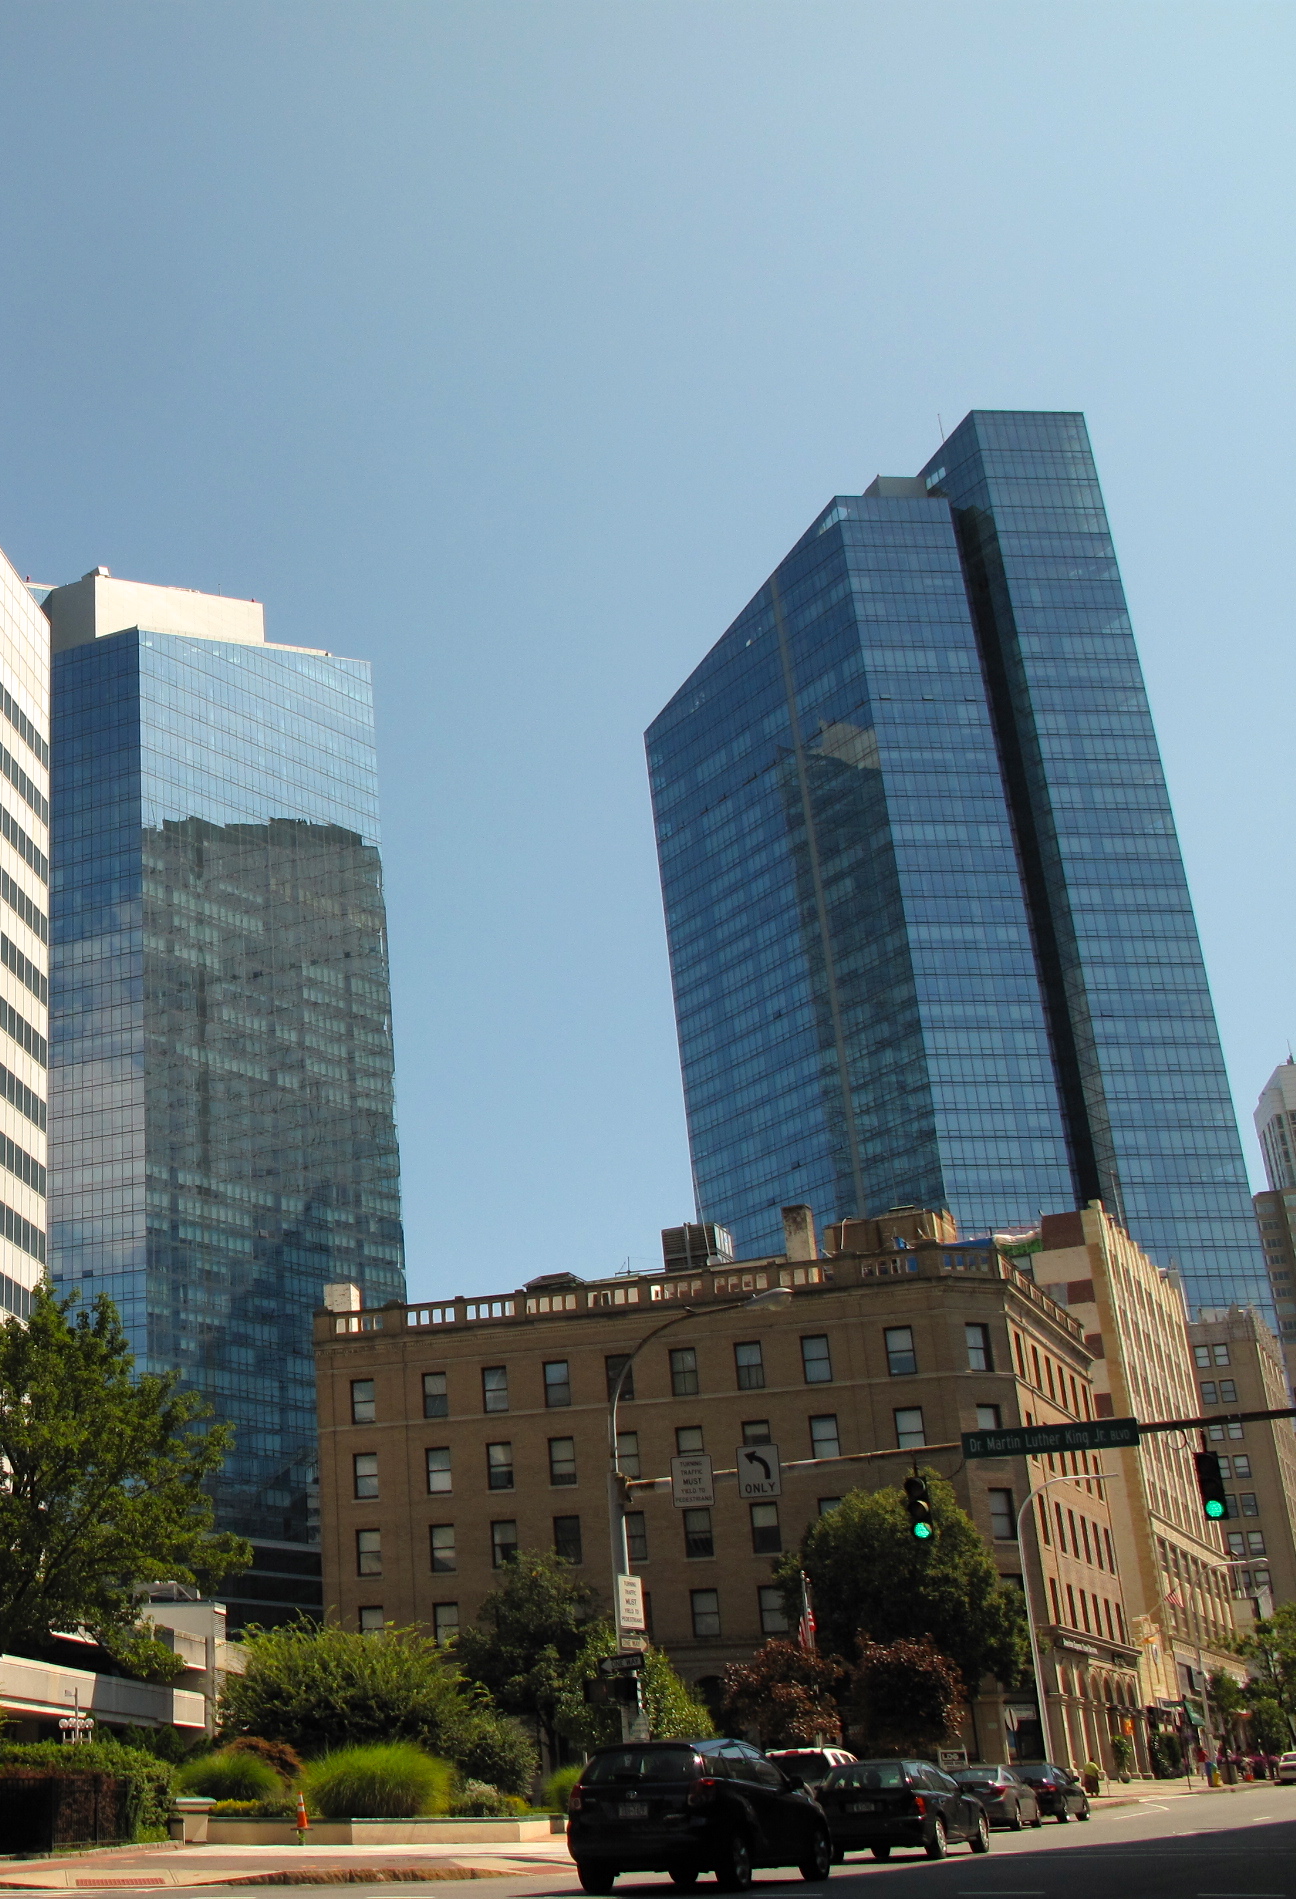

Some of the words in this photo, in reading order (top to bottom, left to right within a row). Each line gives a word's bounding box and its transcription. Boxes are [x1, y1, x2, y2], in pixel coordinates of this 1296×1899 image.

[969, 1438, 984, 1452] Dr.
[986, 1435, 1021, 1451] Martin
[1025, 1433, 1061, 1448] Luther
[1065, 1430, 1089, 1447] King
[1094, 1428, 1106, 1442] Jr.
[1110, 1429, 1130, 1440] BLVD
[745, 1481, 776, 1494] ONLY
[611, 1660, 624, 1668] ONE
[626, 1658, 639, 1666] WAY
